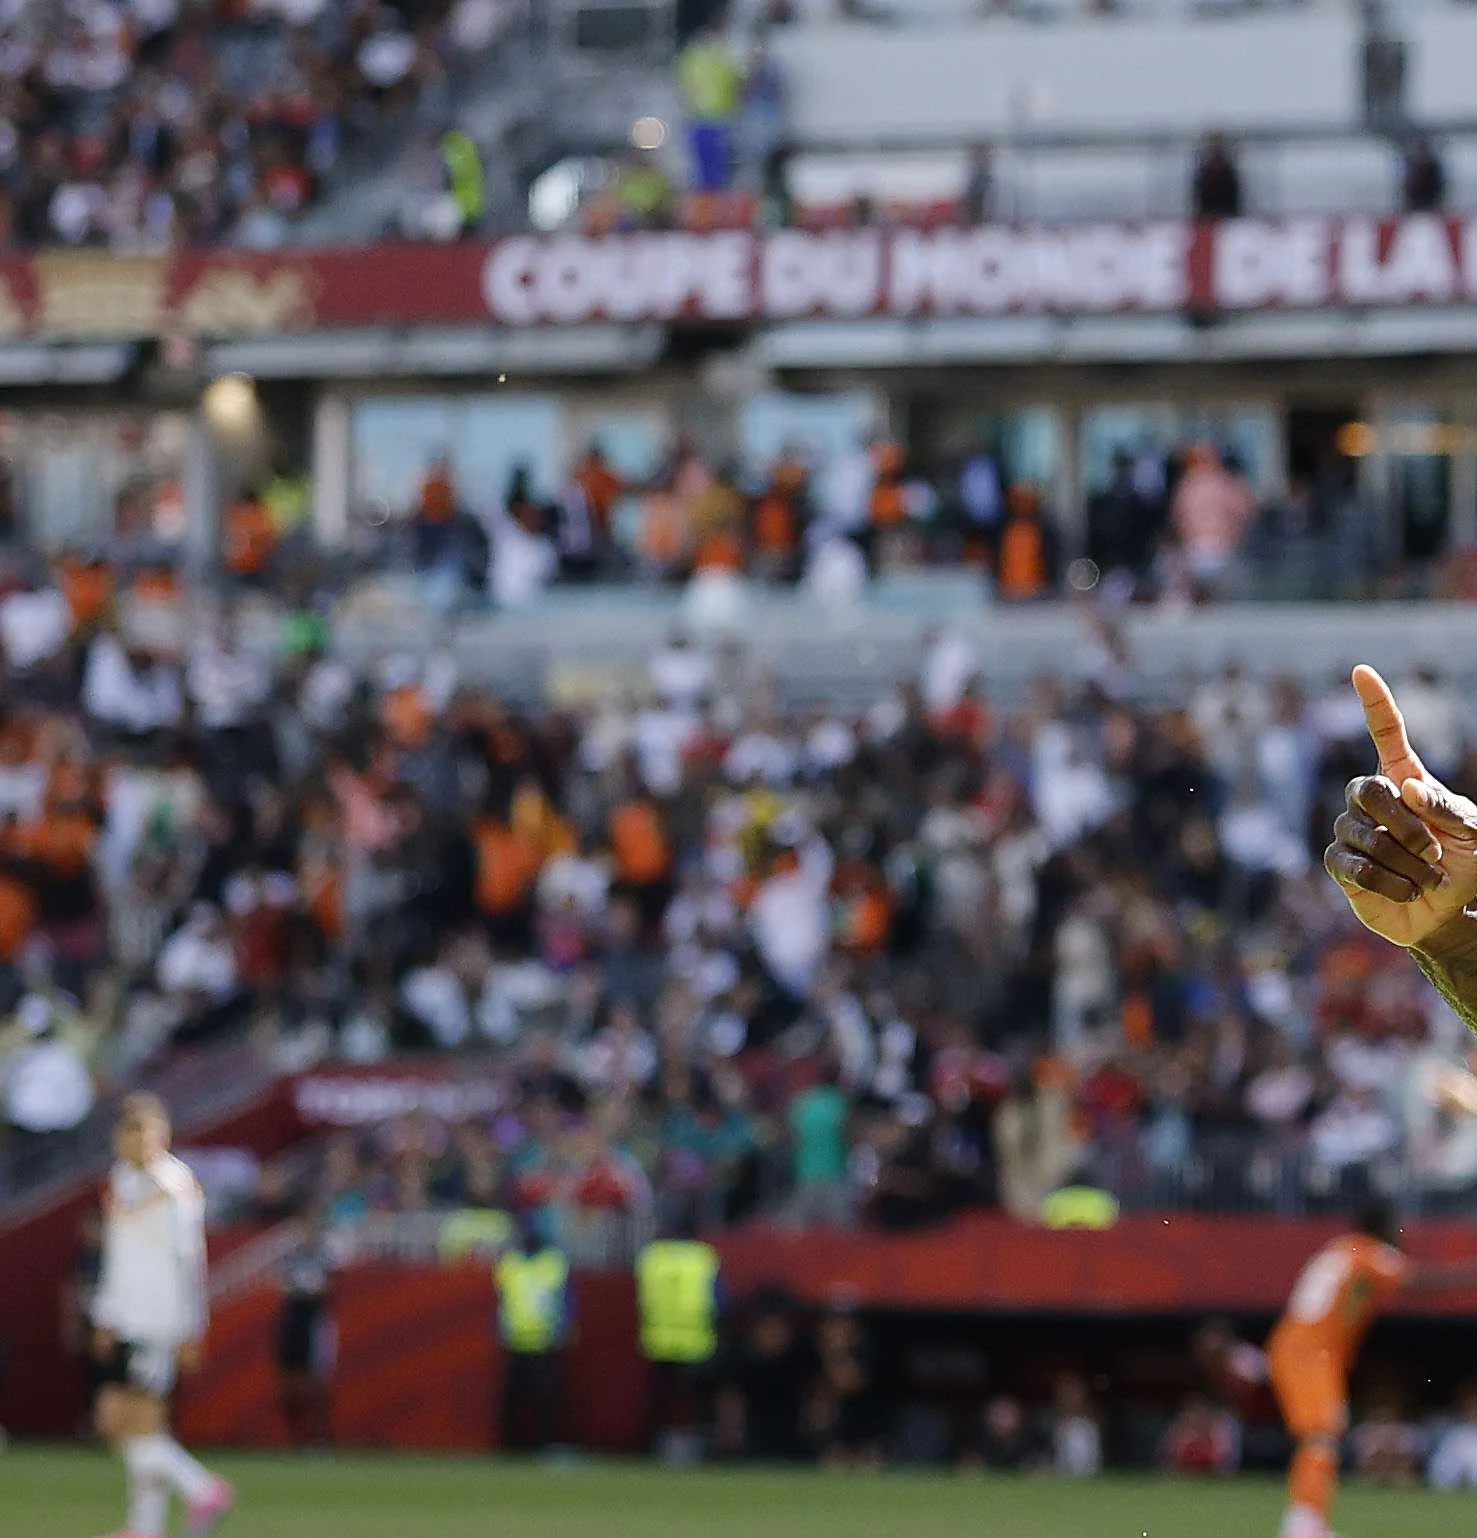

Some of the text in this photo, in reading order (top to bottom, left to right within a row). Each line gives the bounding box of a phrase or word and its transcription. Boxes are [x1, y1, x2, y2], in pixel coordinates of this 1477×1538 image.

[483, 231, 748, 326] COUPE
[763, 228, 885, 317] DU
[891, 219, 1188, 314] MONDE
[1213, 213, 1330, 310] DE
[1335, 209, 1454, 304] LA
